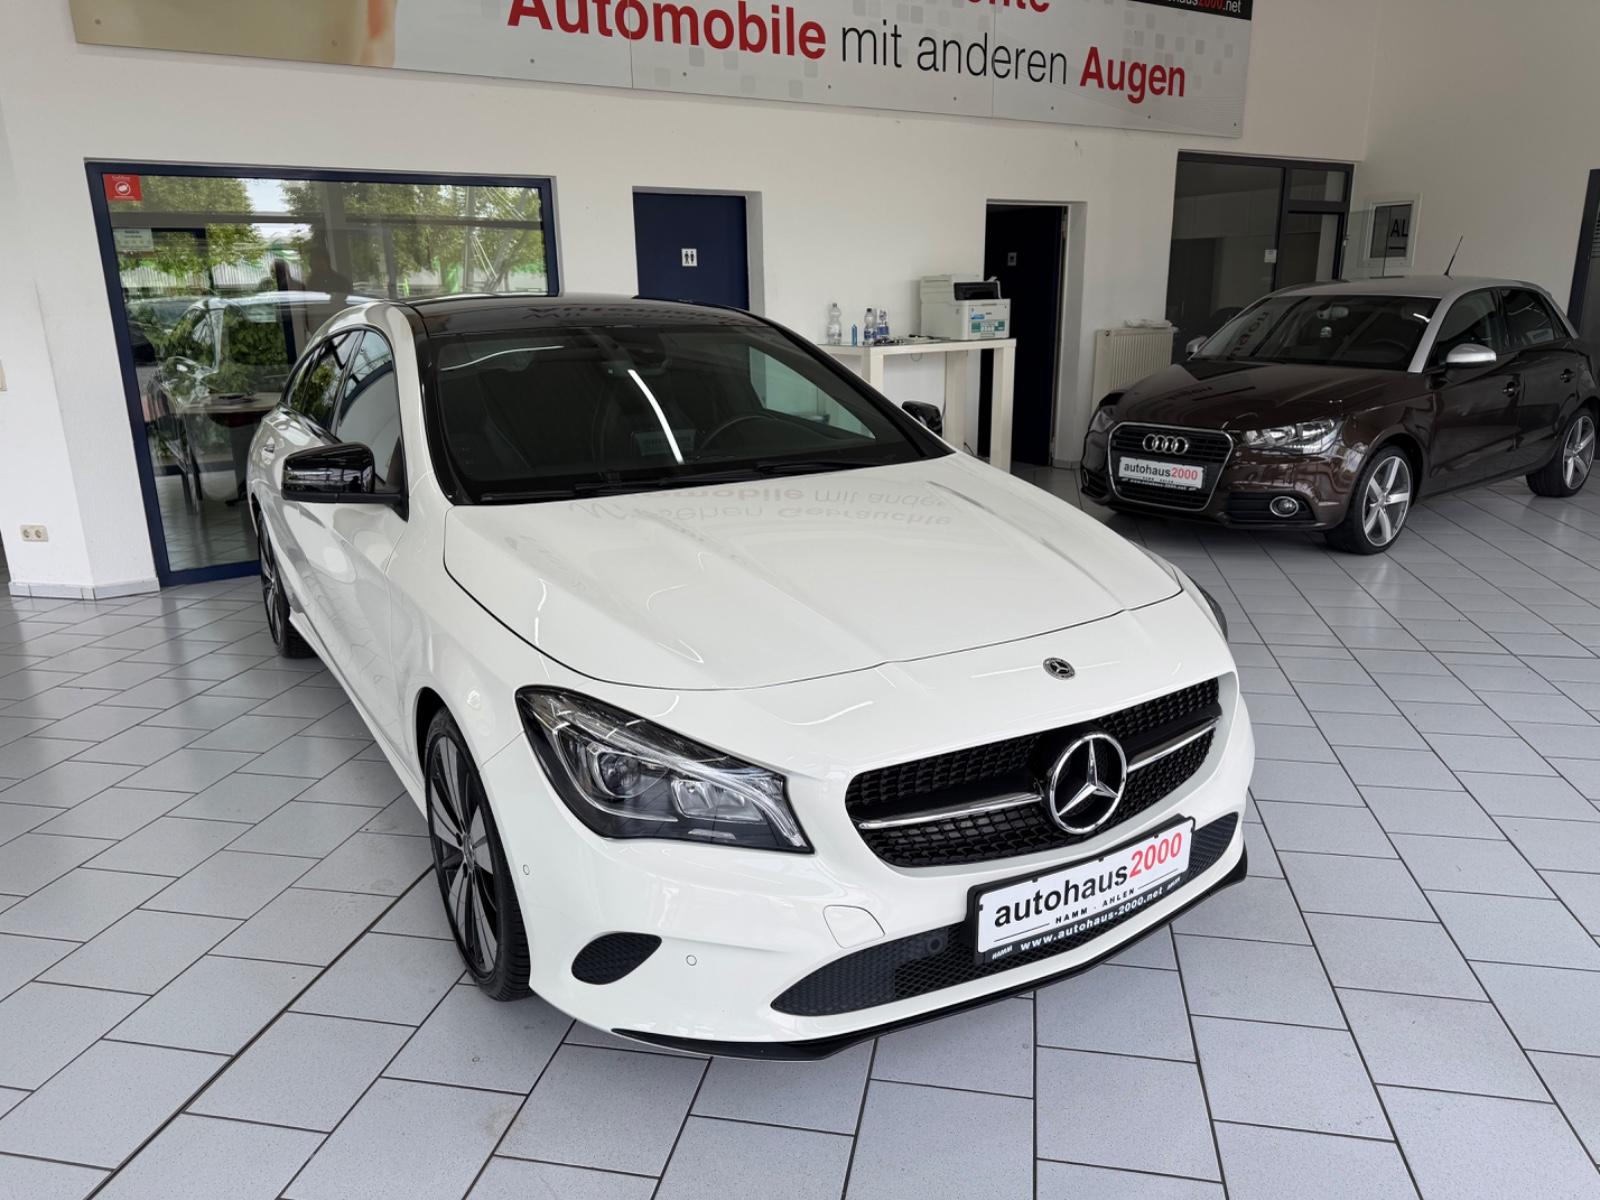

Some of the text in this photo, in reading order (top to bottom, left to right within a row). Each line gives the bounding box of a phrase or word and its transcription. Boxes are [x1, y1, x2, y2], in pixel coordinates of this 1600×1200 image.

[507, 0, 1186, 104] Automobile mit anderen Augen
[1123, 461, 1199, 481] autohaus2000
[994, 832, 1183, 927] autohaus2000
[1055, 888, 1135, 924] HAMM AHLEN
[1020, 886, 1163, 951] www.autohaus-2000.net
